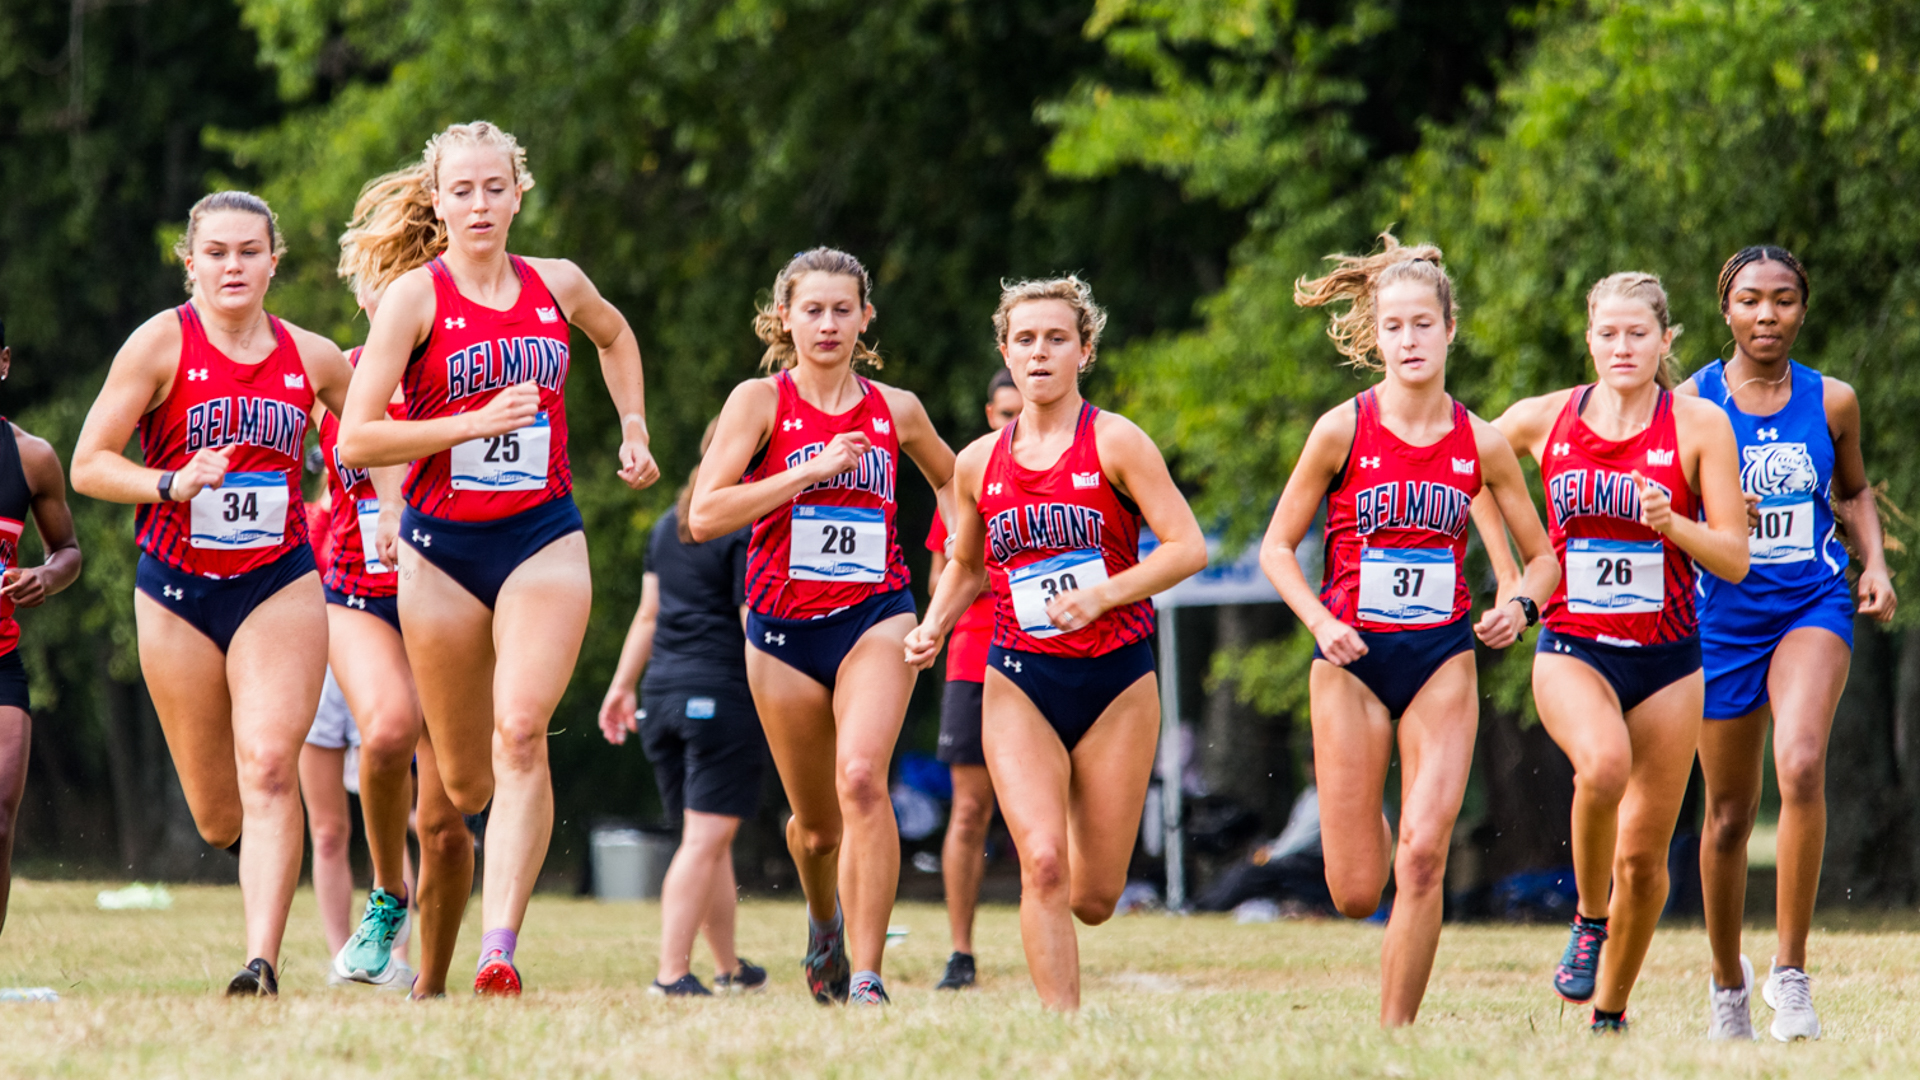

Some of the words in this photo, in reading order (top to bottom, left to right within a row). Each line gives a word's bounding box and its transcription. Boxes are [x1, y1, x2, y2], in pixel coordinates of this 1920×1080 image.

[446, 336, 570, 404] BELMONT
[185, 396, 306, 462] BELMONT
[483, 433, 520, 463] 25
[223, 492, 258, 522] 34
[1355, 481, 1472, 540] BELMONT
[821, 524, 856, 555] 28
[988, 502, 1105, 566] BELMONT
[1756, 510, 1794, 539] 107
[1393, 567, 1425, 597] 37
[1596, 557, 1632, 587] 26
